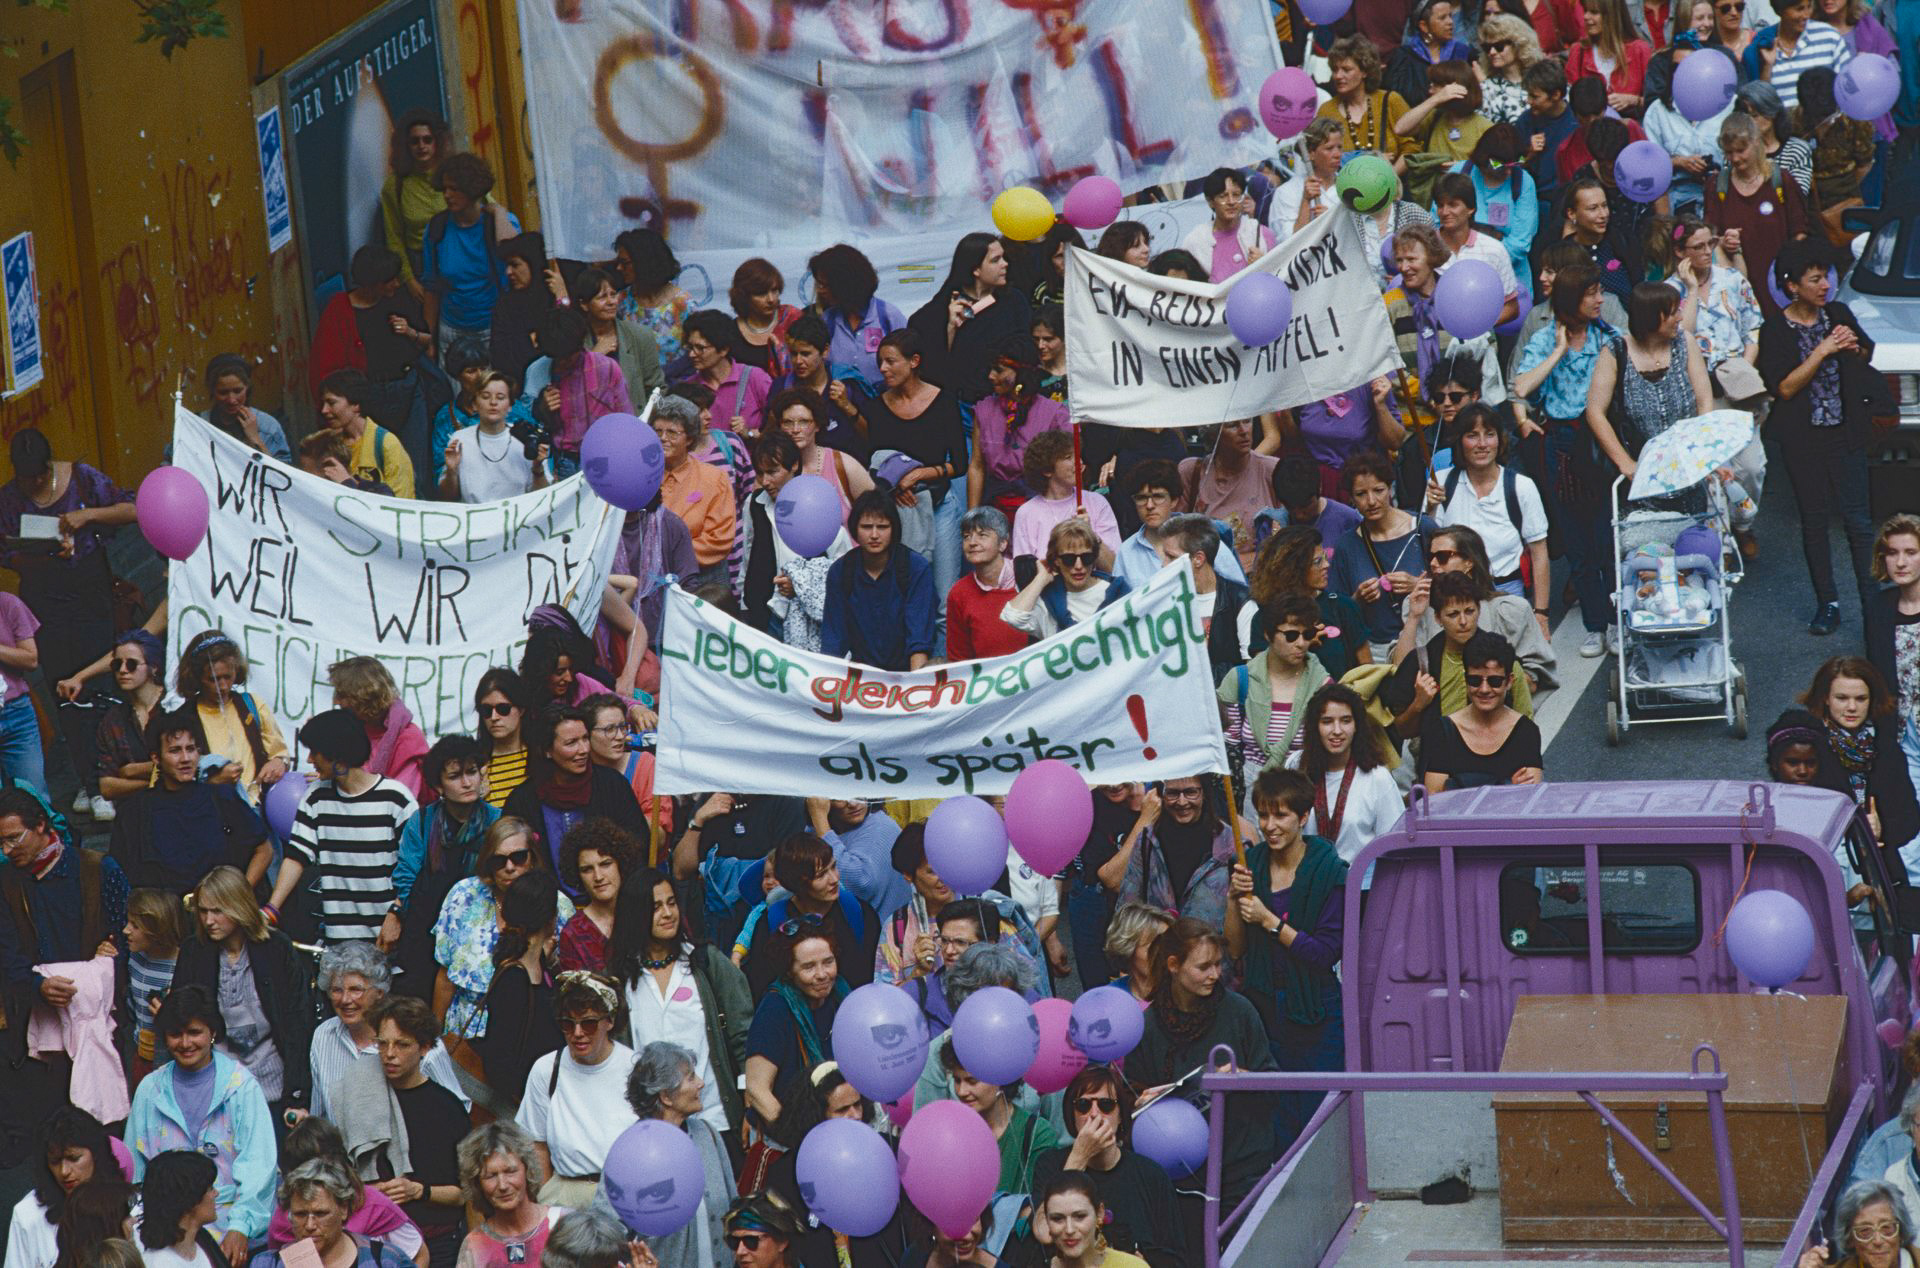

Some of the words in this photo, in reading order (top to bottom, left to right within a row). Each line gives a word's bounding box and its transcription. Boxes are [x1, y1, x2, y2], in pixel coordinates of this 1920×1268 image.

[292, 87, 324, 134] DER
[335, 18, 432, 105] AUFSTEIGER.
[1112, 341, 1142, 386] IN
[1160, 345, 1241, 388] EINEN
[211, 440, 292, 533] WIR
[207, 526, 314, 628] WEIL
[365, 558, 471, 646] WIR
[811, 570, 1206, 723] gleichberechtigt
[818, 741, 909, 784] als
